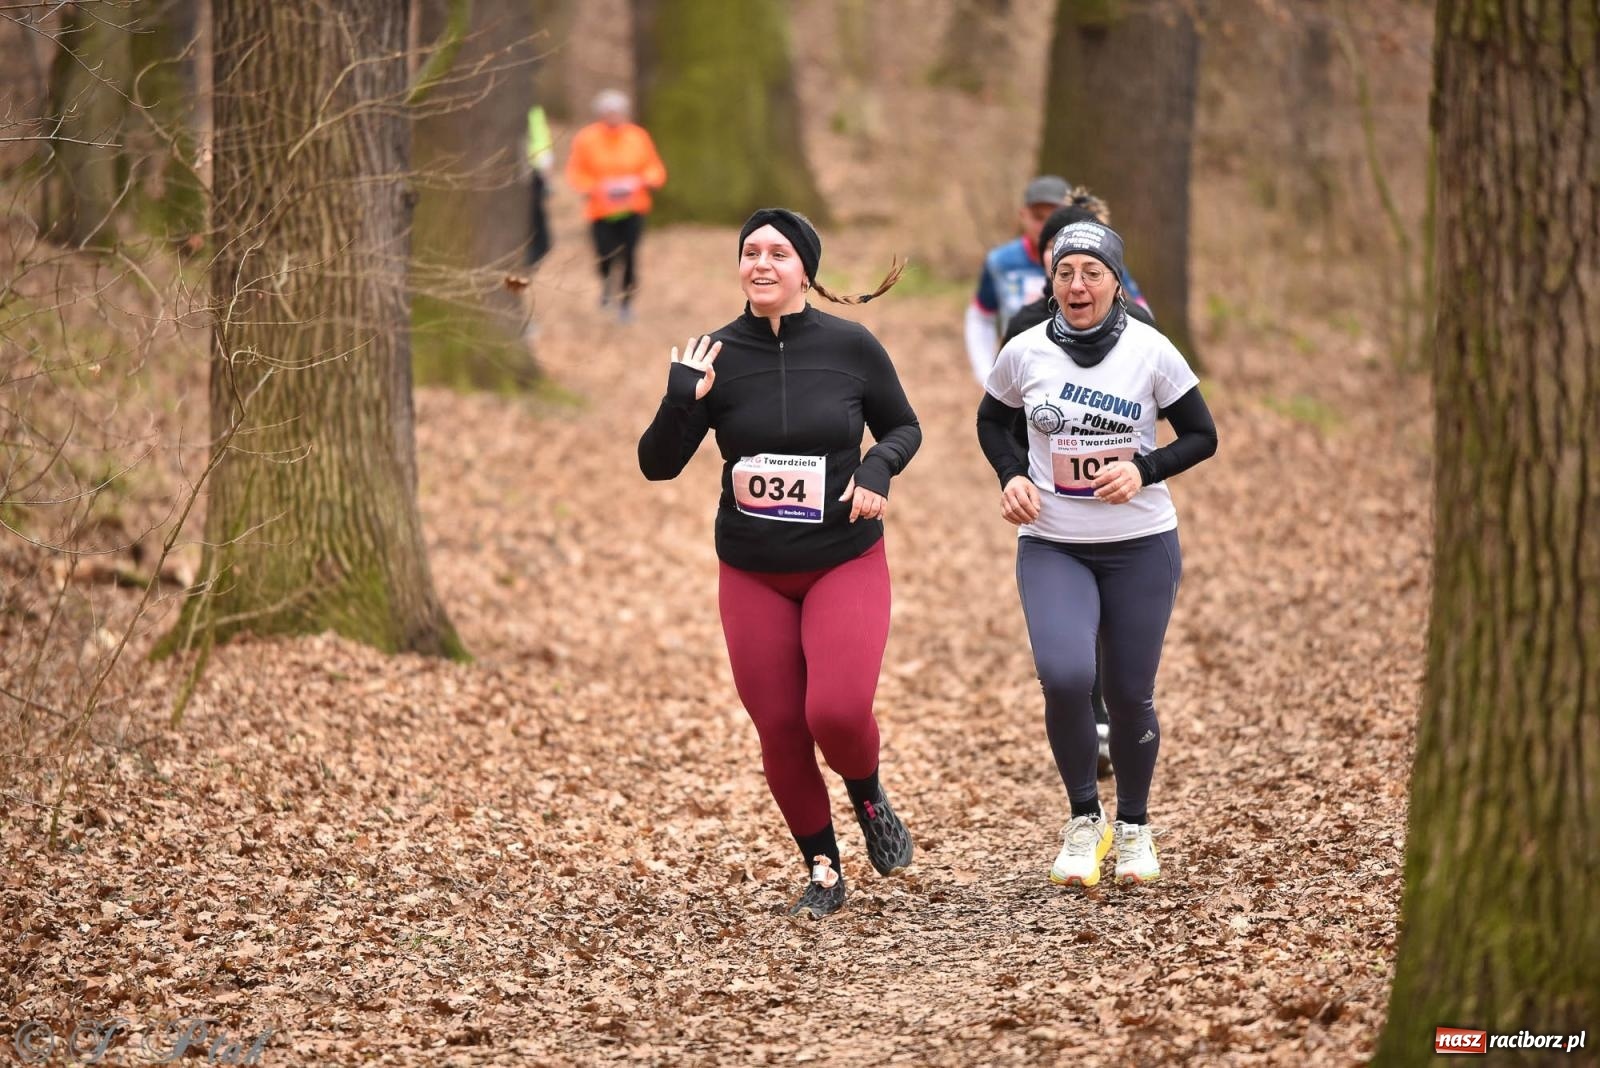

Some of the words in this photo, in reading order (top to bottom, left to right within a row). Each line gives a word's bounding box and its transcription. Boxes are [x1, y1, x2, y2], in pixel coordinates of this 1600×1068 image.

[1059, 382, 1141, 421] BIEGOWO
[1057, 438, 1078, 446] BIEG
[1080, 436, 1132, 447] Twardziela
[764, 457, 817, 467] Twardziela
[1070, 456, 1119, 481] 10
[749, 475, 807, 503] 034
